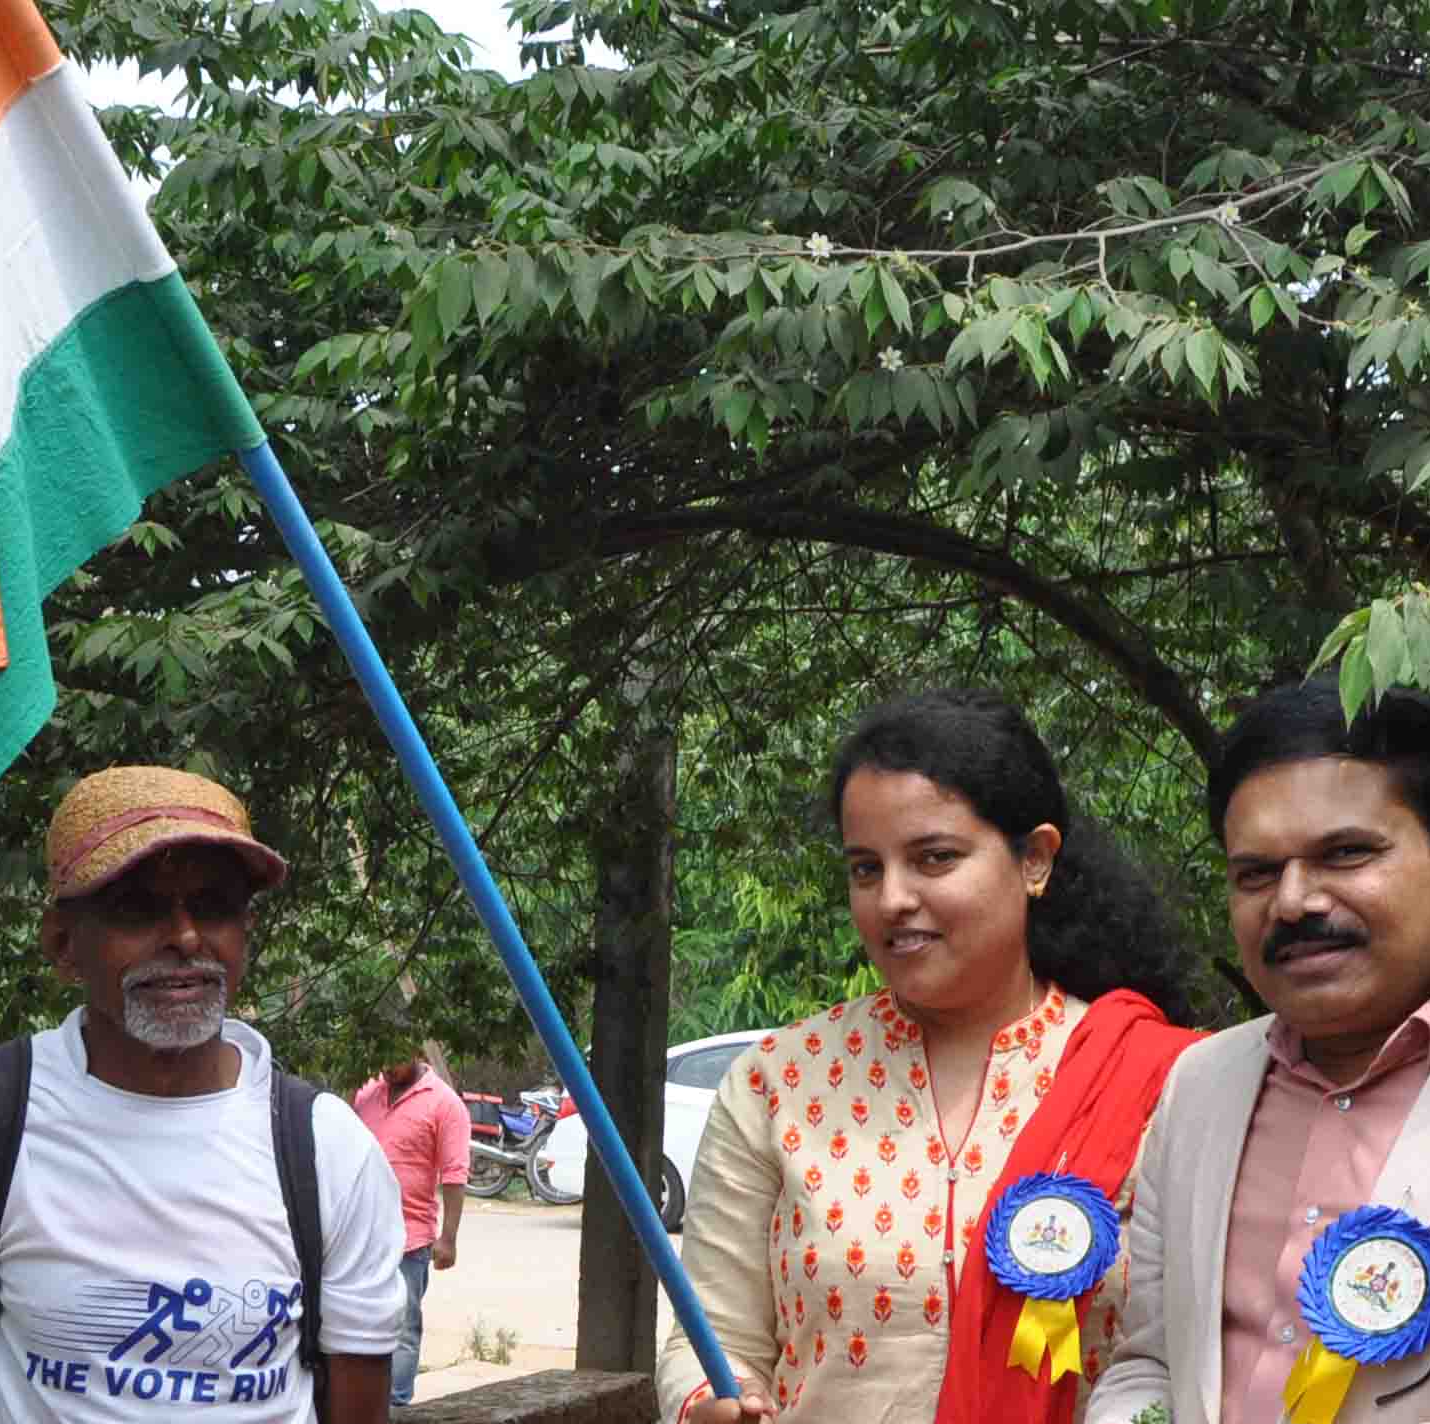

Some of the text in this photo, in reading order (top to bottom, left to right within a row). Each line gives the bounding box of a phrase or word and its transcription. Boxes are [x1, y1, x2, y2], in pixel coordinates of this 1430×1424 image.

[26, 1352, 291, 1403] THE VOTE RUN
